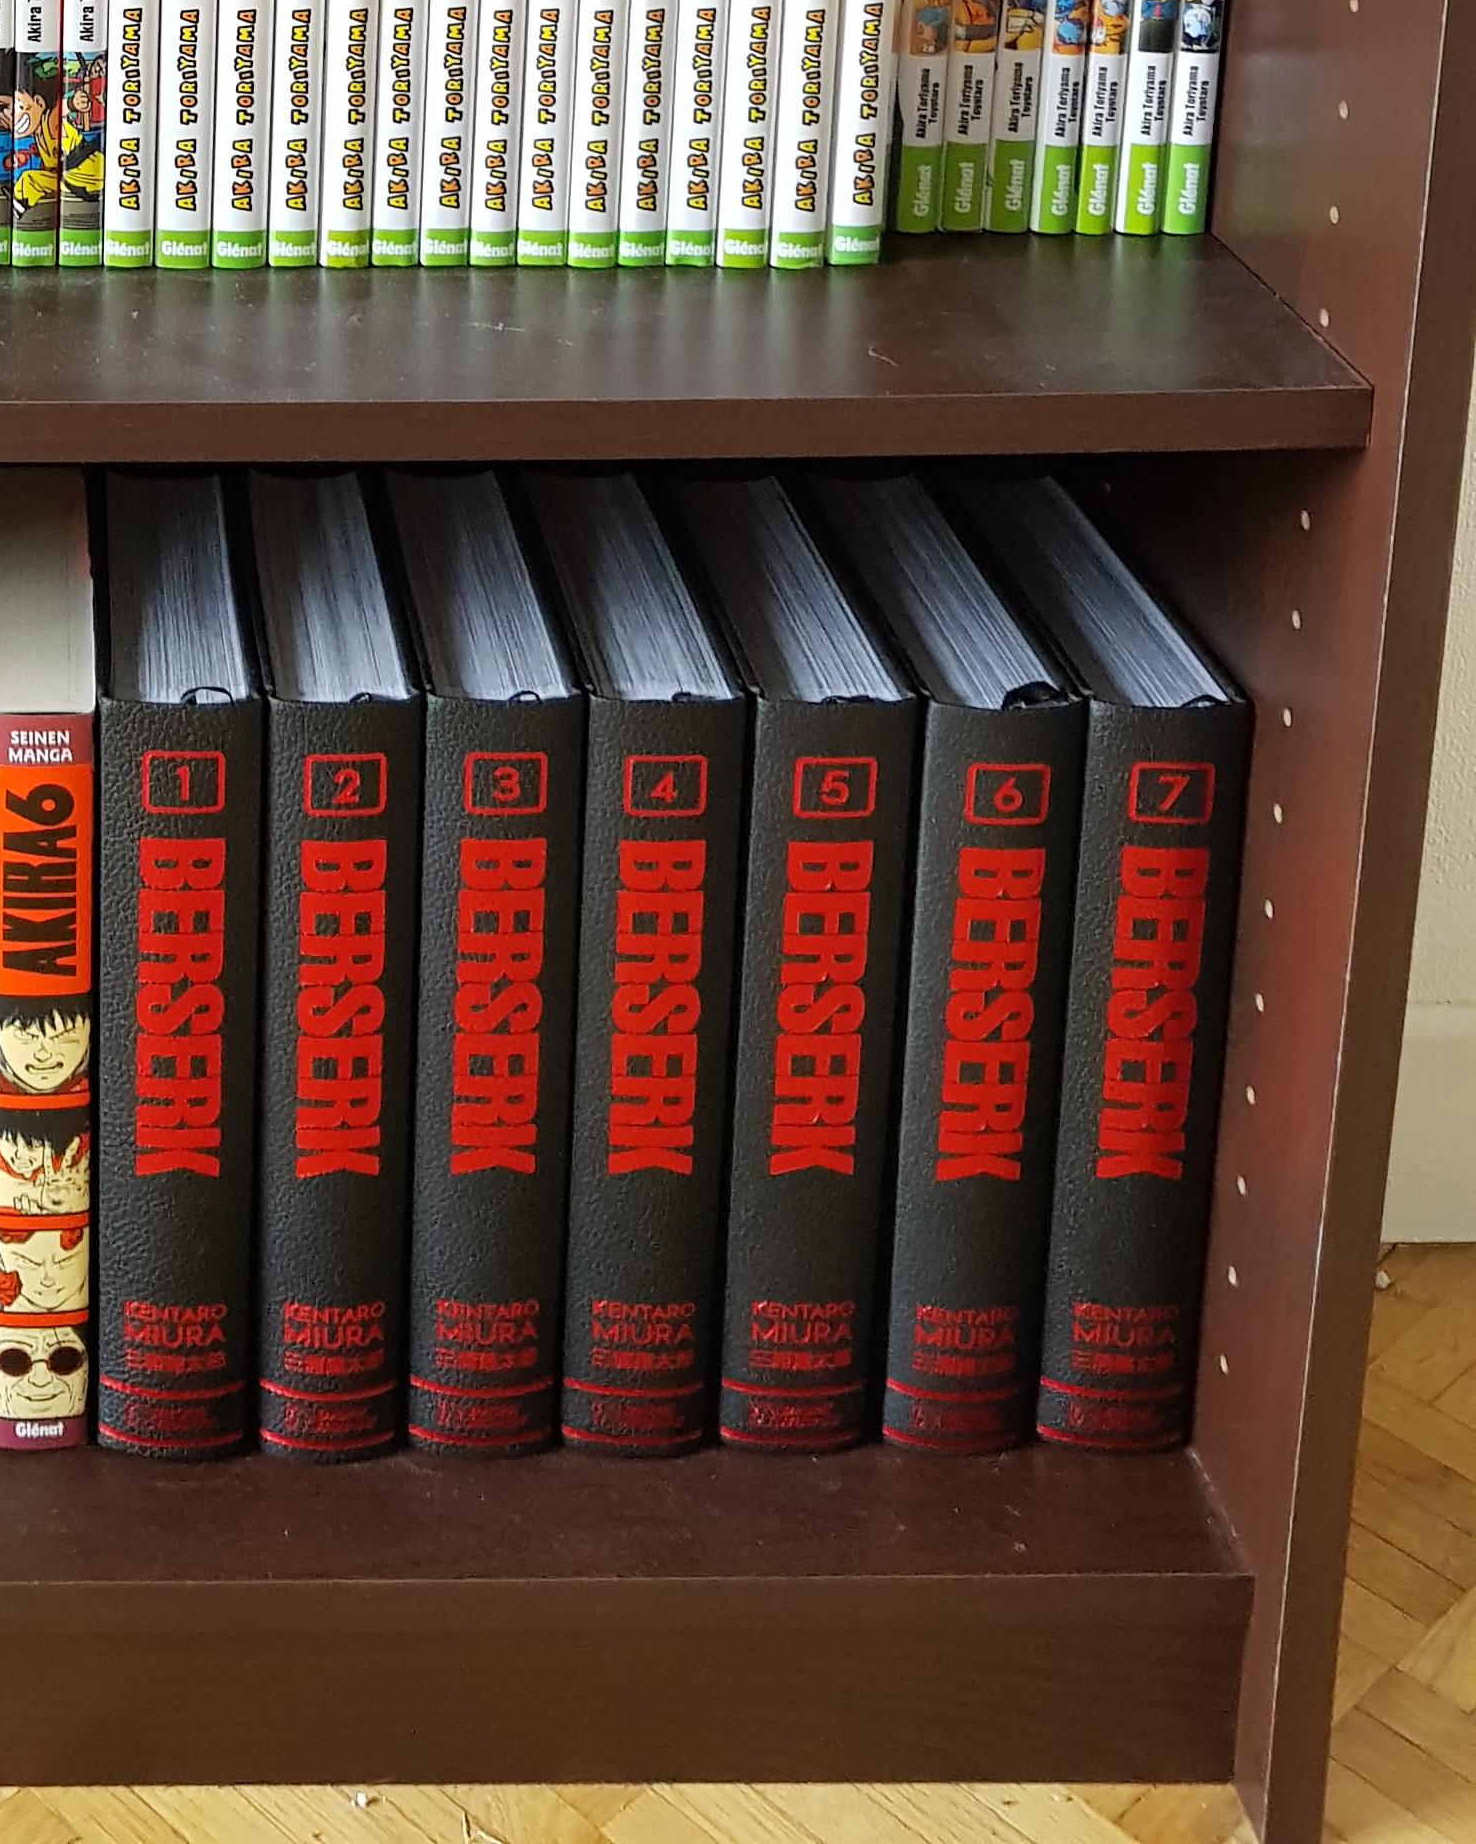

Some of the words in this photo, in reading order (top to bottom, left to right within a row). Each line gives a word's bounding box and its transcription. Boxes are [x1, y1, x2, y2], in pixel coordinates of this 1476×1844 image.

[179, 8, 200, 125] TORIYAMA
[860, 1, 885, 119] TORIYAMA
[175, 137, 198, 212] AKIRA
[851, 132, 876, 208] AKIRA
[1179, 163, 1199, 215] Glénat
[834, 233, 881, 254] Glénat
[5, 780, 75, 820] 6
[177, 766, 189, 800] 1
[333, 769, 360, 804] 2
[651, 772, 675, 803] 4
[820, 770, 848, 806] 5
[1158, 775, 1188, 812] 7
[2, 824, 78, 977] AKIRA
[135, 838, 224, 1176] BERSERK
[296, 840, 386, 1178] BERSERK
[608, 840, 705, 1174] BERSERK
[770, 841, 872, 1175] BERSERK
[1095, 845, 1207, 1178] BERSERK
[284, 1301, 385, 1324] KENTARO
[284, 1322, 384, 1350] MIURA
[750, 1321, 852, 1346] MIURA
